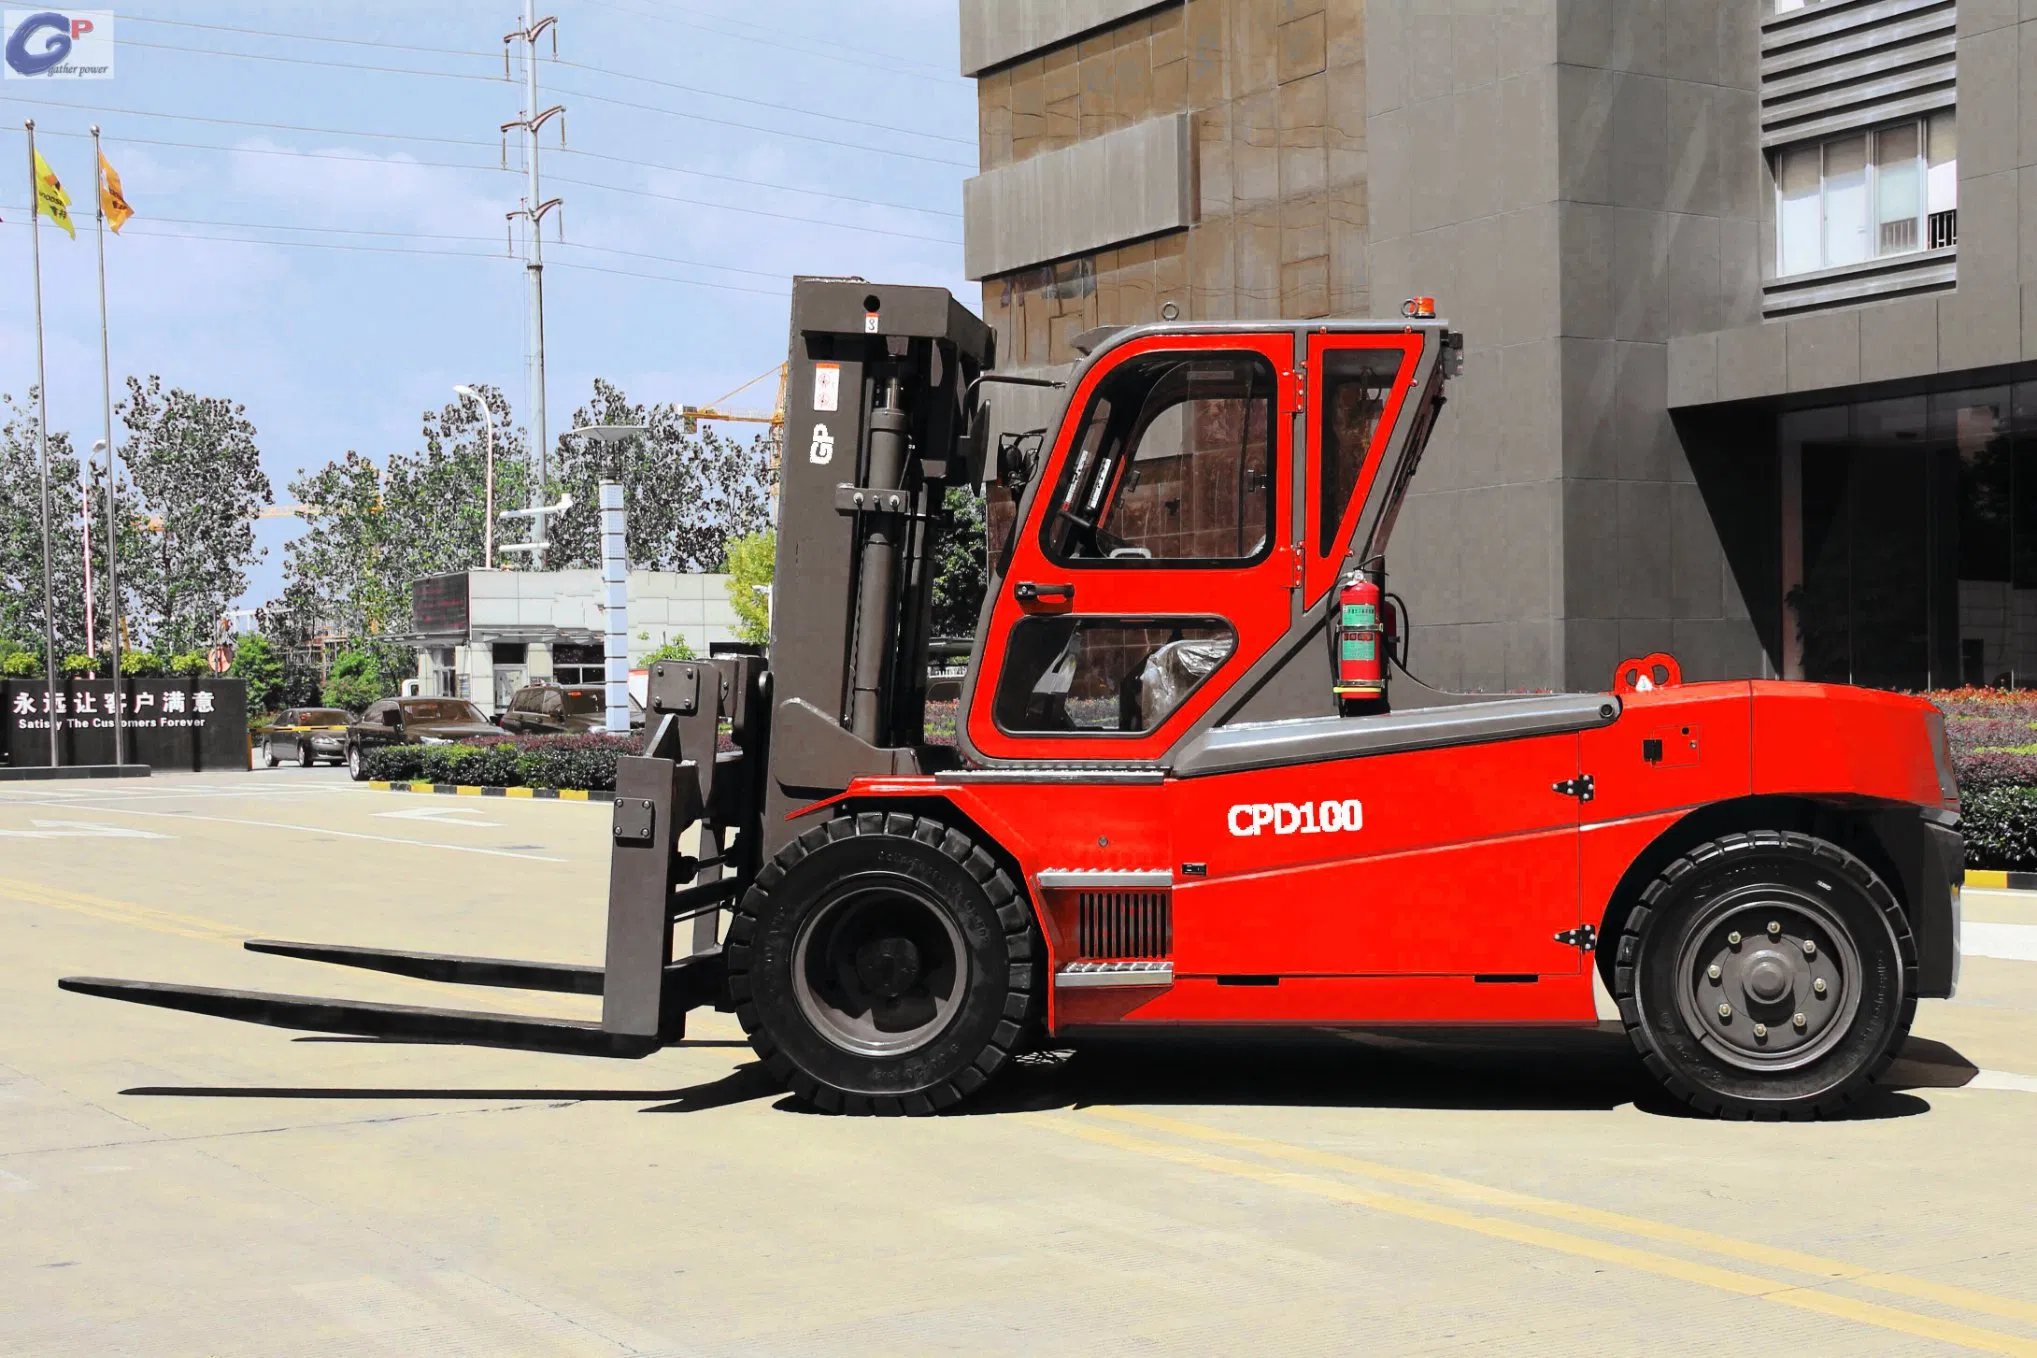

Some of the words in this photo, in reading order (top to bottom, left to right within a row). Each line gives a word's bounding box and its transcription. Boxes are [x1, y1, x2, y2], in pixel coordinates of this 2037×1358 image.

[18, 718, 62, 731] Satisy
[67, 718, 89, 729] The
[92, 718, 157, 729] Cusomers
[160, 717, 205, 727] Forever
[1227, 799, 1363, 837] CPD100
